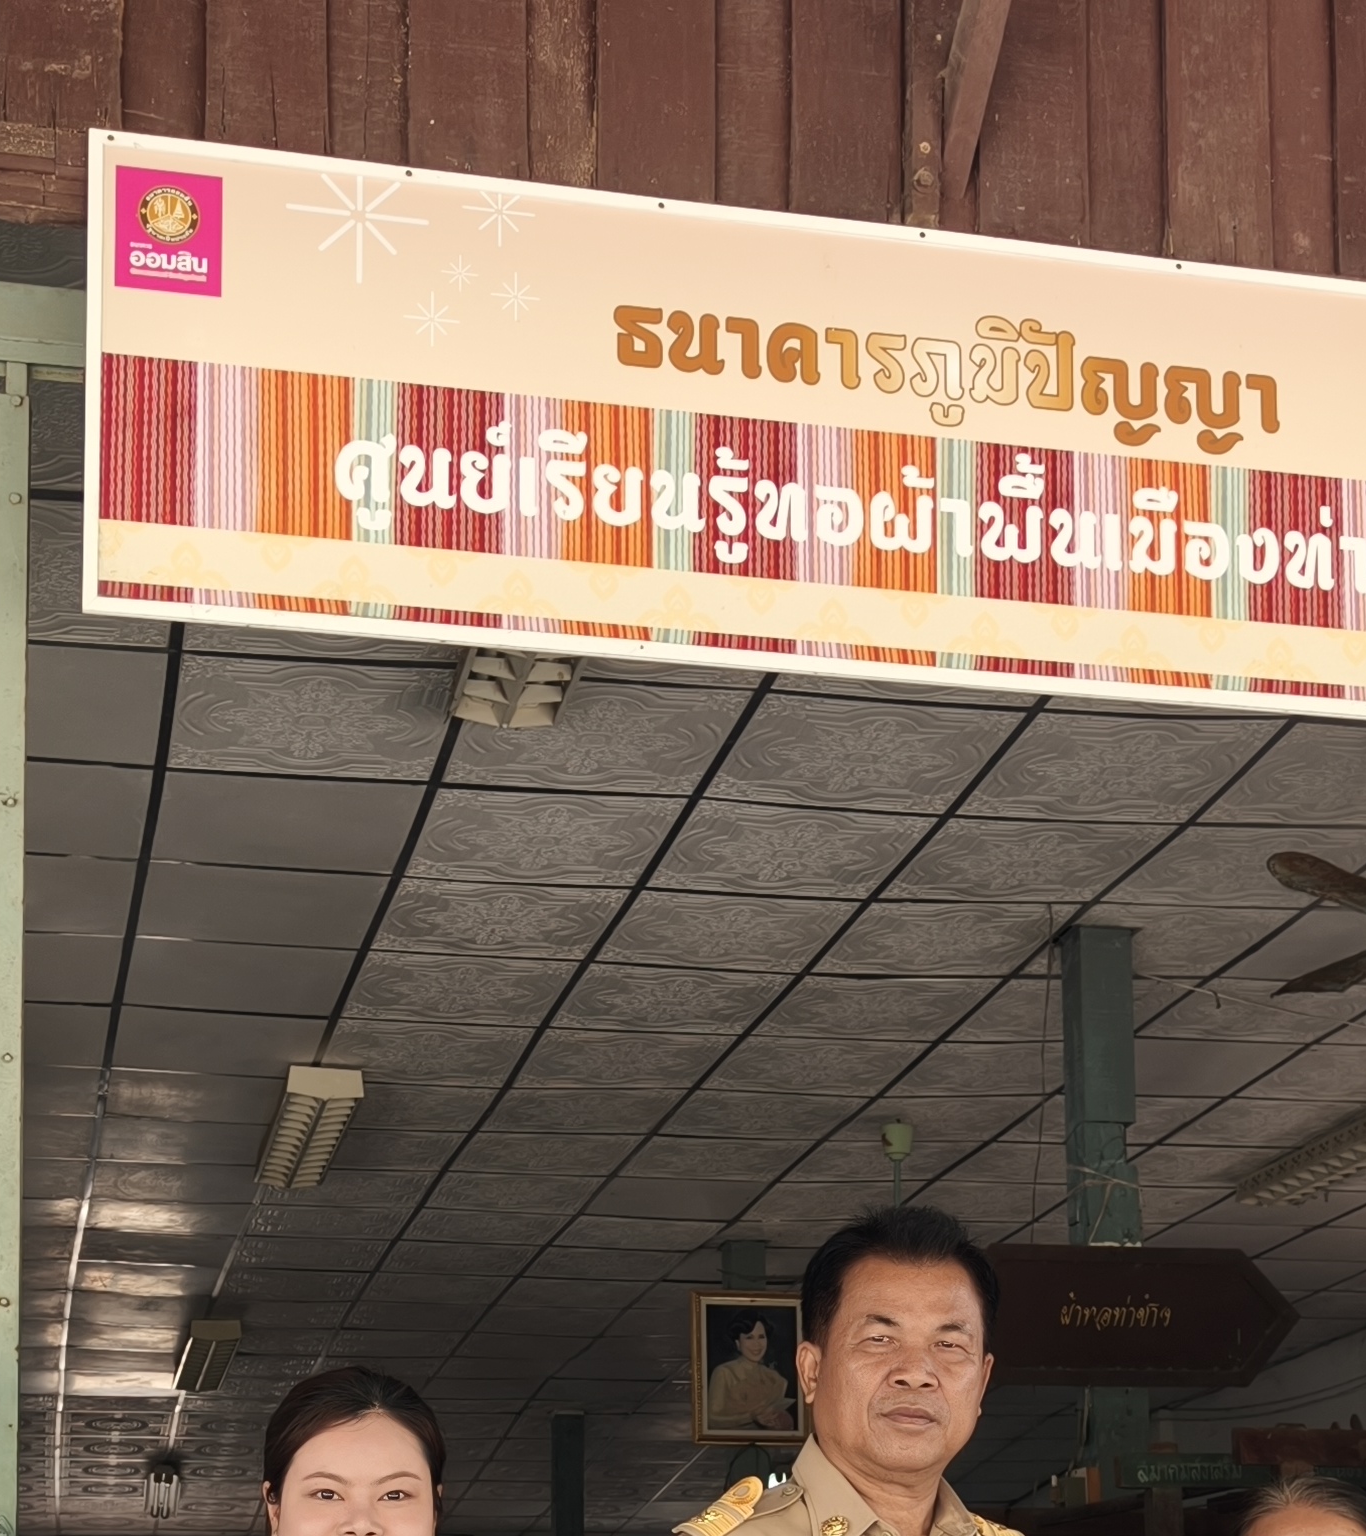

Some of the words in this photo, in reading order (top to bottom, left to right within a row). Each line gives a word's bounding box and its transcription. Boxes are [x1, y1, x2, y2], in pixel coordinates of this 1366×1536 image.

[129, 250, 208, 274] ออมสิน
[612, 303, 1281, 454] ธนาคารภูมิปัญญา
